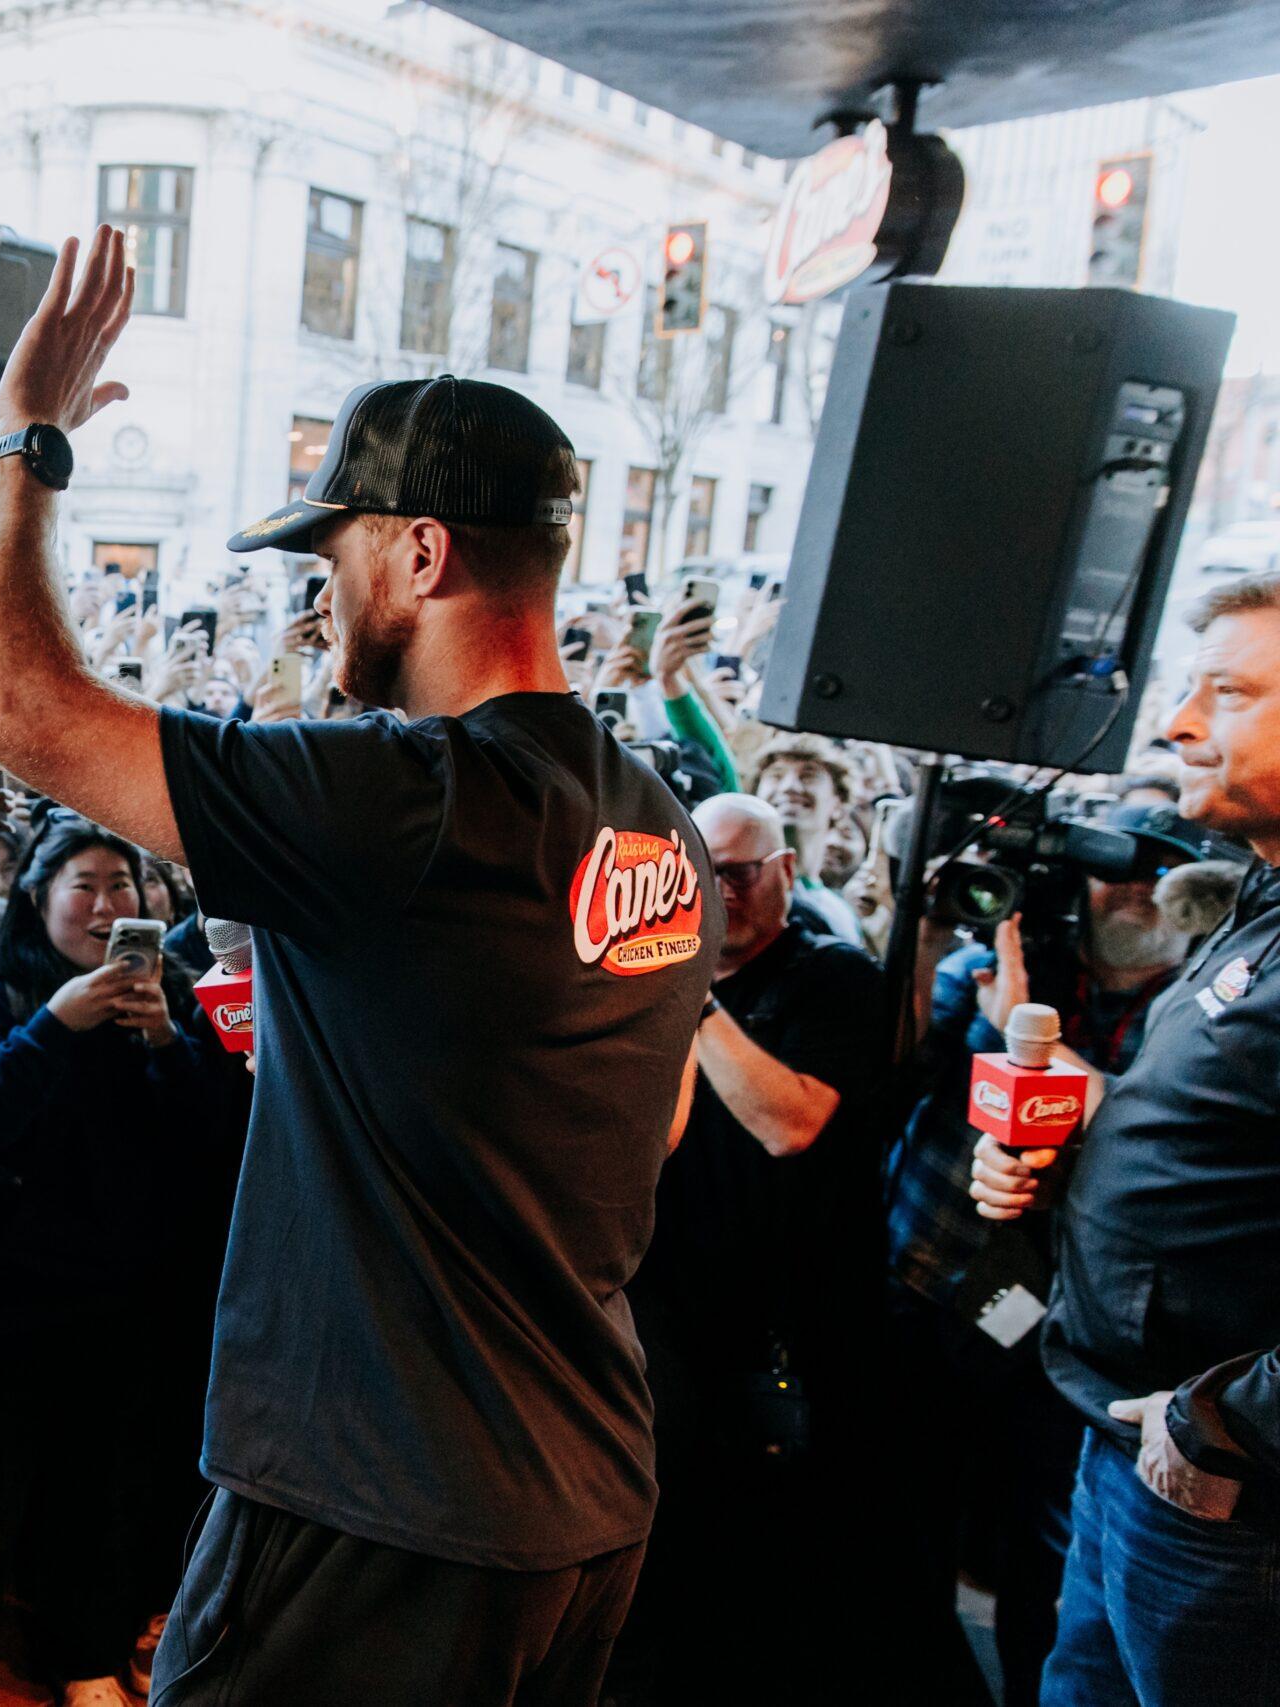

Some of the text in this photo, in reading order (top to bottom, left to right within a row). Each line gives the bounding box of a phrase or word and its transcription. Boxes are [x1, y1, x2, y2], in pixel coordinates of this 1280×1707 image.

[617, 836, 662, 862] Raising
[574, 826, 698, 964] Cane's
[617, 938, 697, 962] CHICKEN FINGERS
[216, 1002, 254, 1031] Cane'
